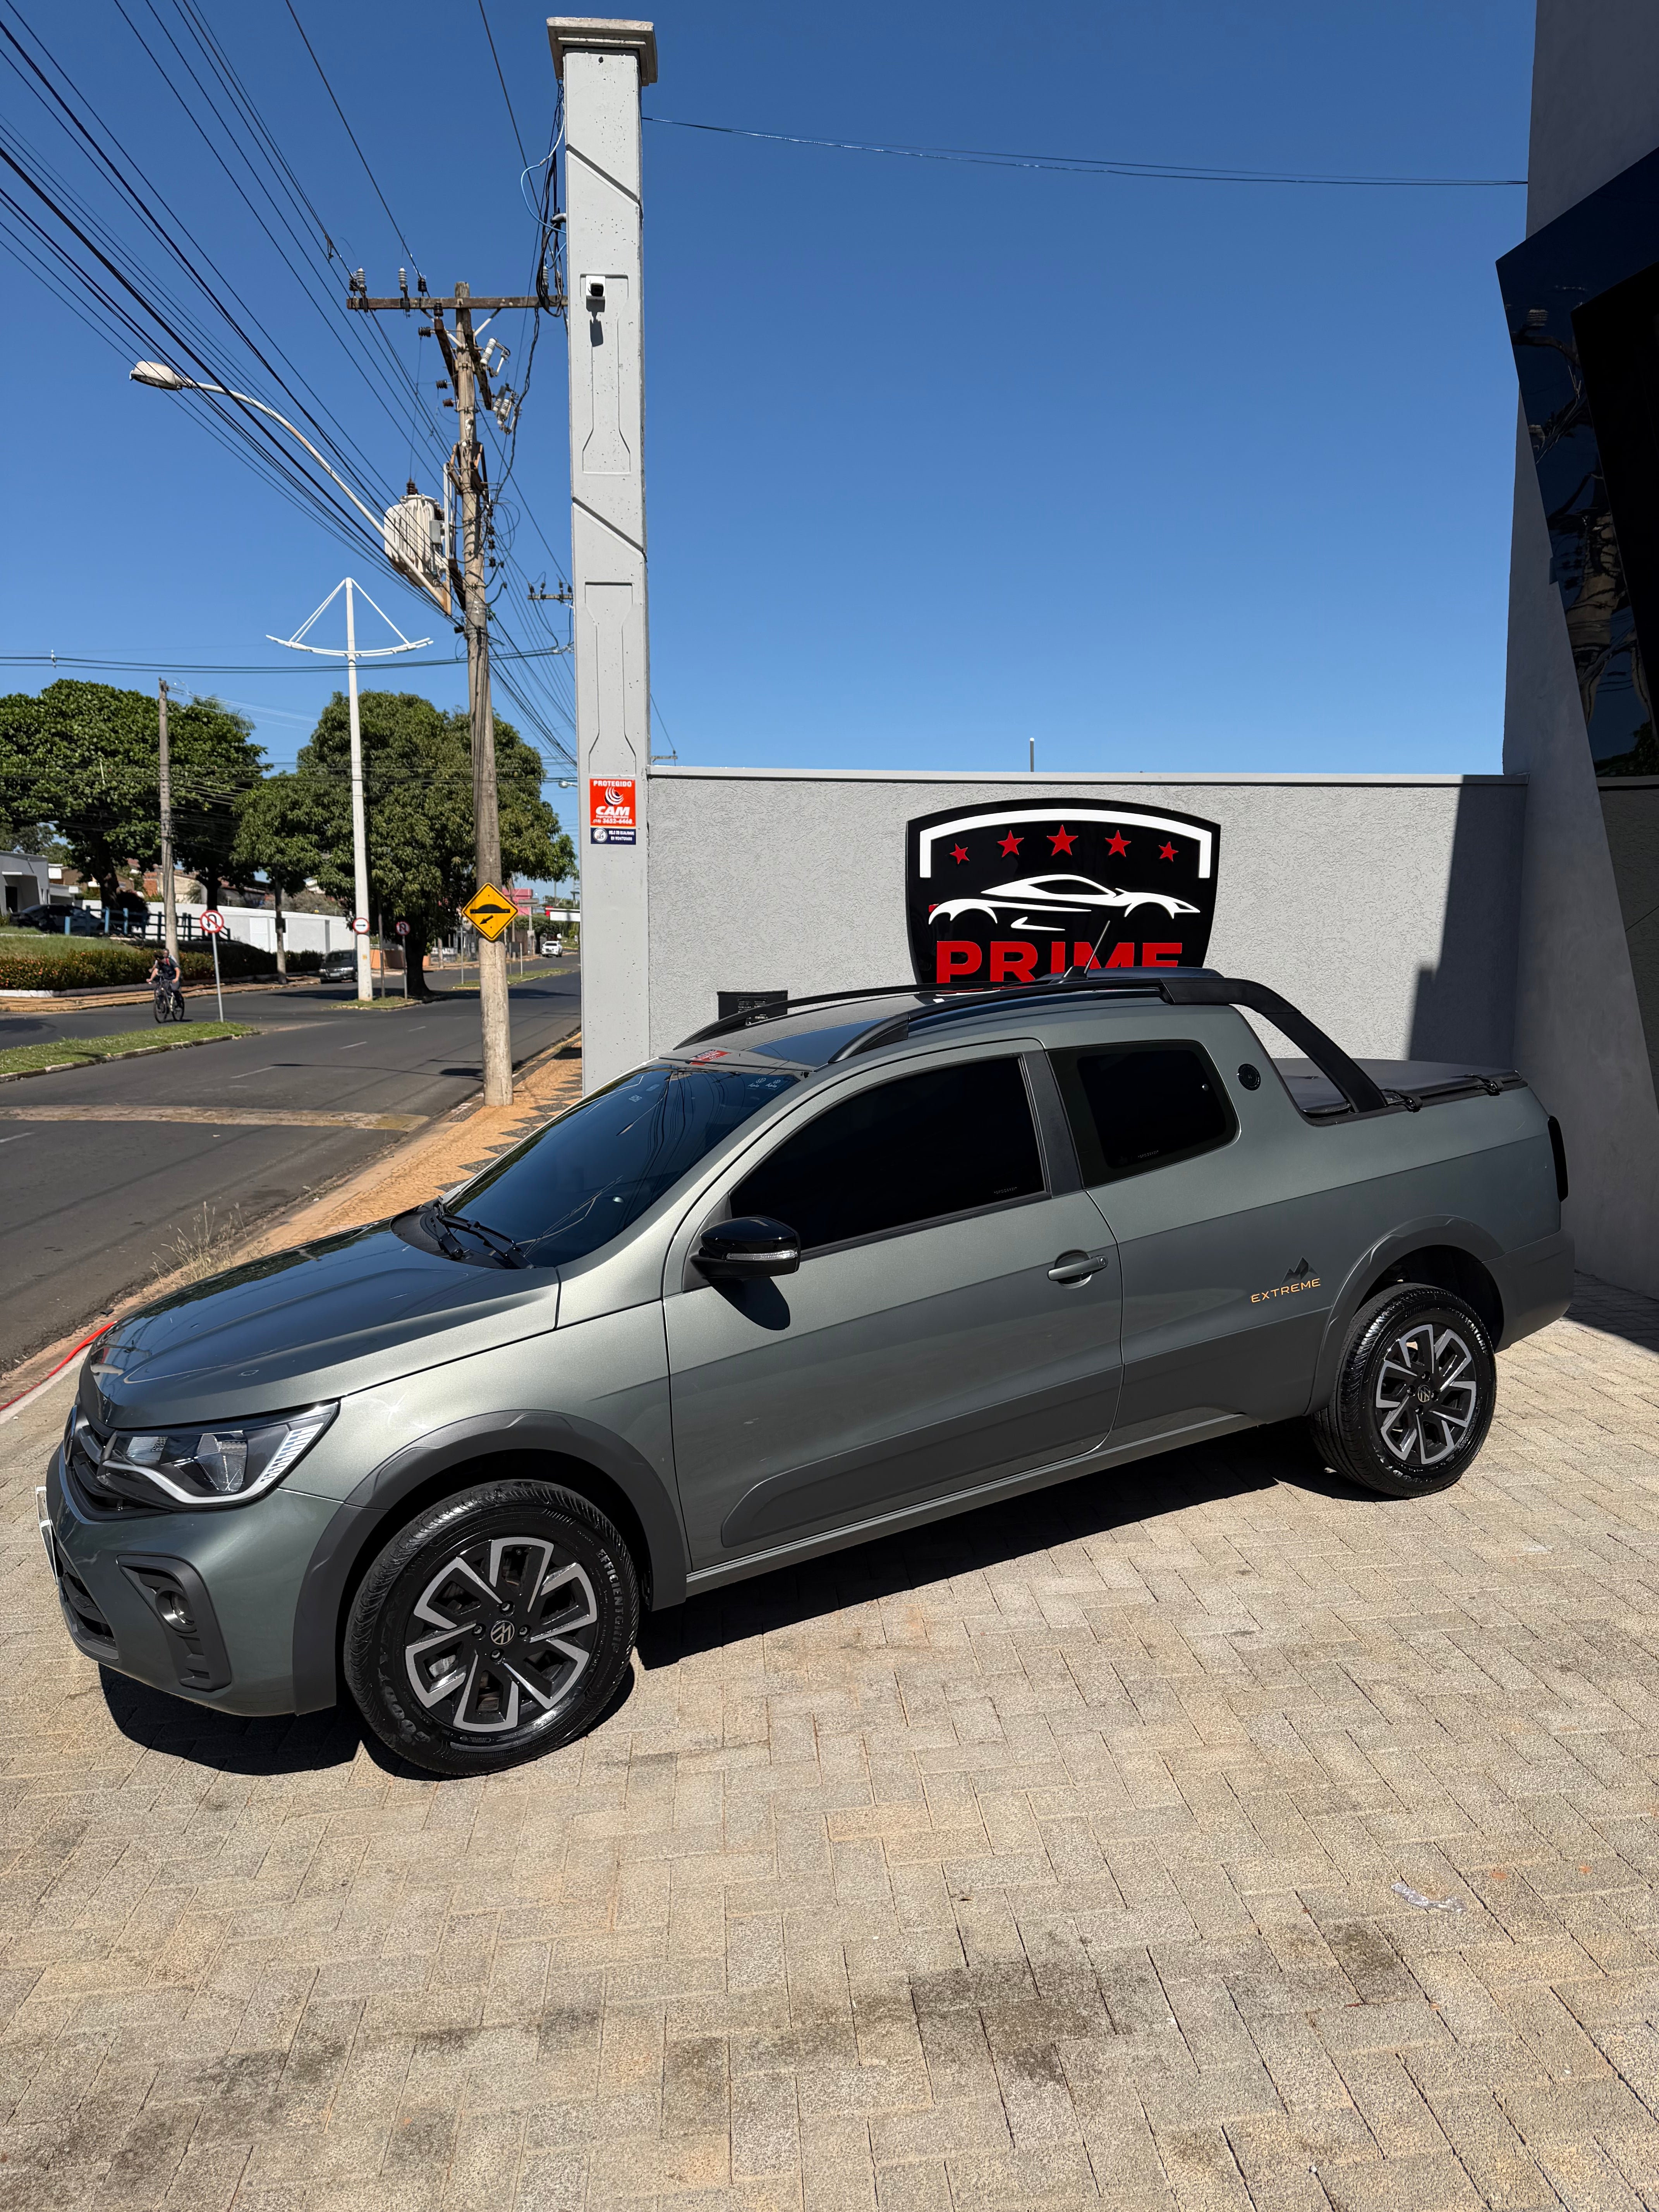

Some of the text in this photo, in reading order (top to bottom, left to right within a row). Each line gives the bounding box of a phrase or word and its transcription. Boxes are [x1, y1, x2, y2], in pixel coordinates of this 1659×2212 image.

[596, 806, 630, 816] CAM
[936, 941, 1182, 984] PRIME
[1250, 1278, 1321, 1303] EXTREME
